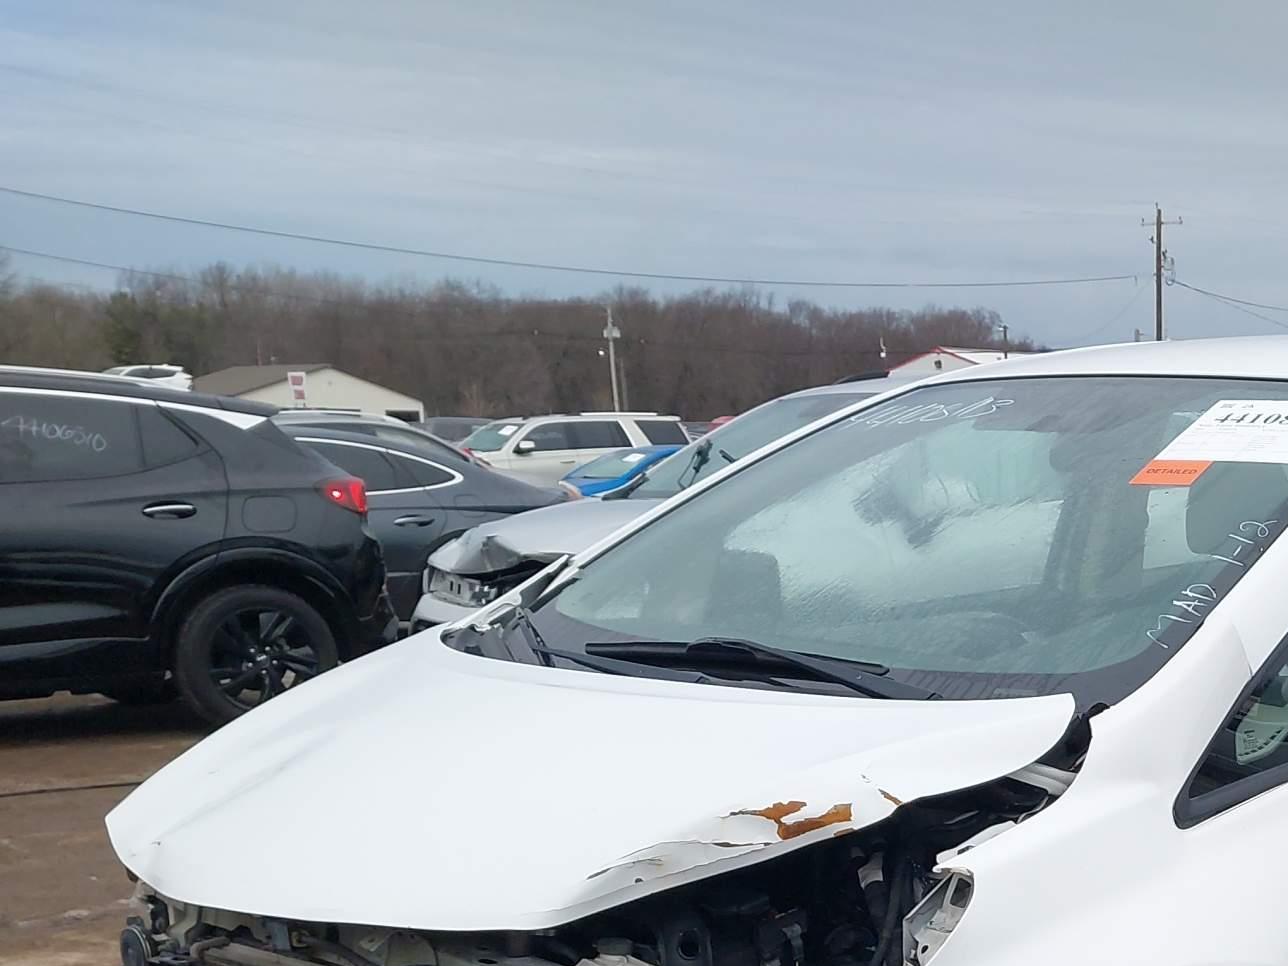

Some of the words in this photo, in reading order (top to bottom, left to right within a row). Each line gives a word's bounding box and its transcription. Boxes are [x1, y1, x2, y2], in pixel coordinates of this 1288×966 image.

[1146, 468, 1198, 476] DETAILED
[1146, 583, 1217, 649] MAD
[1212, 520, 1279, 567] 1-12
